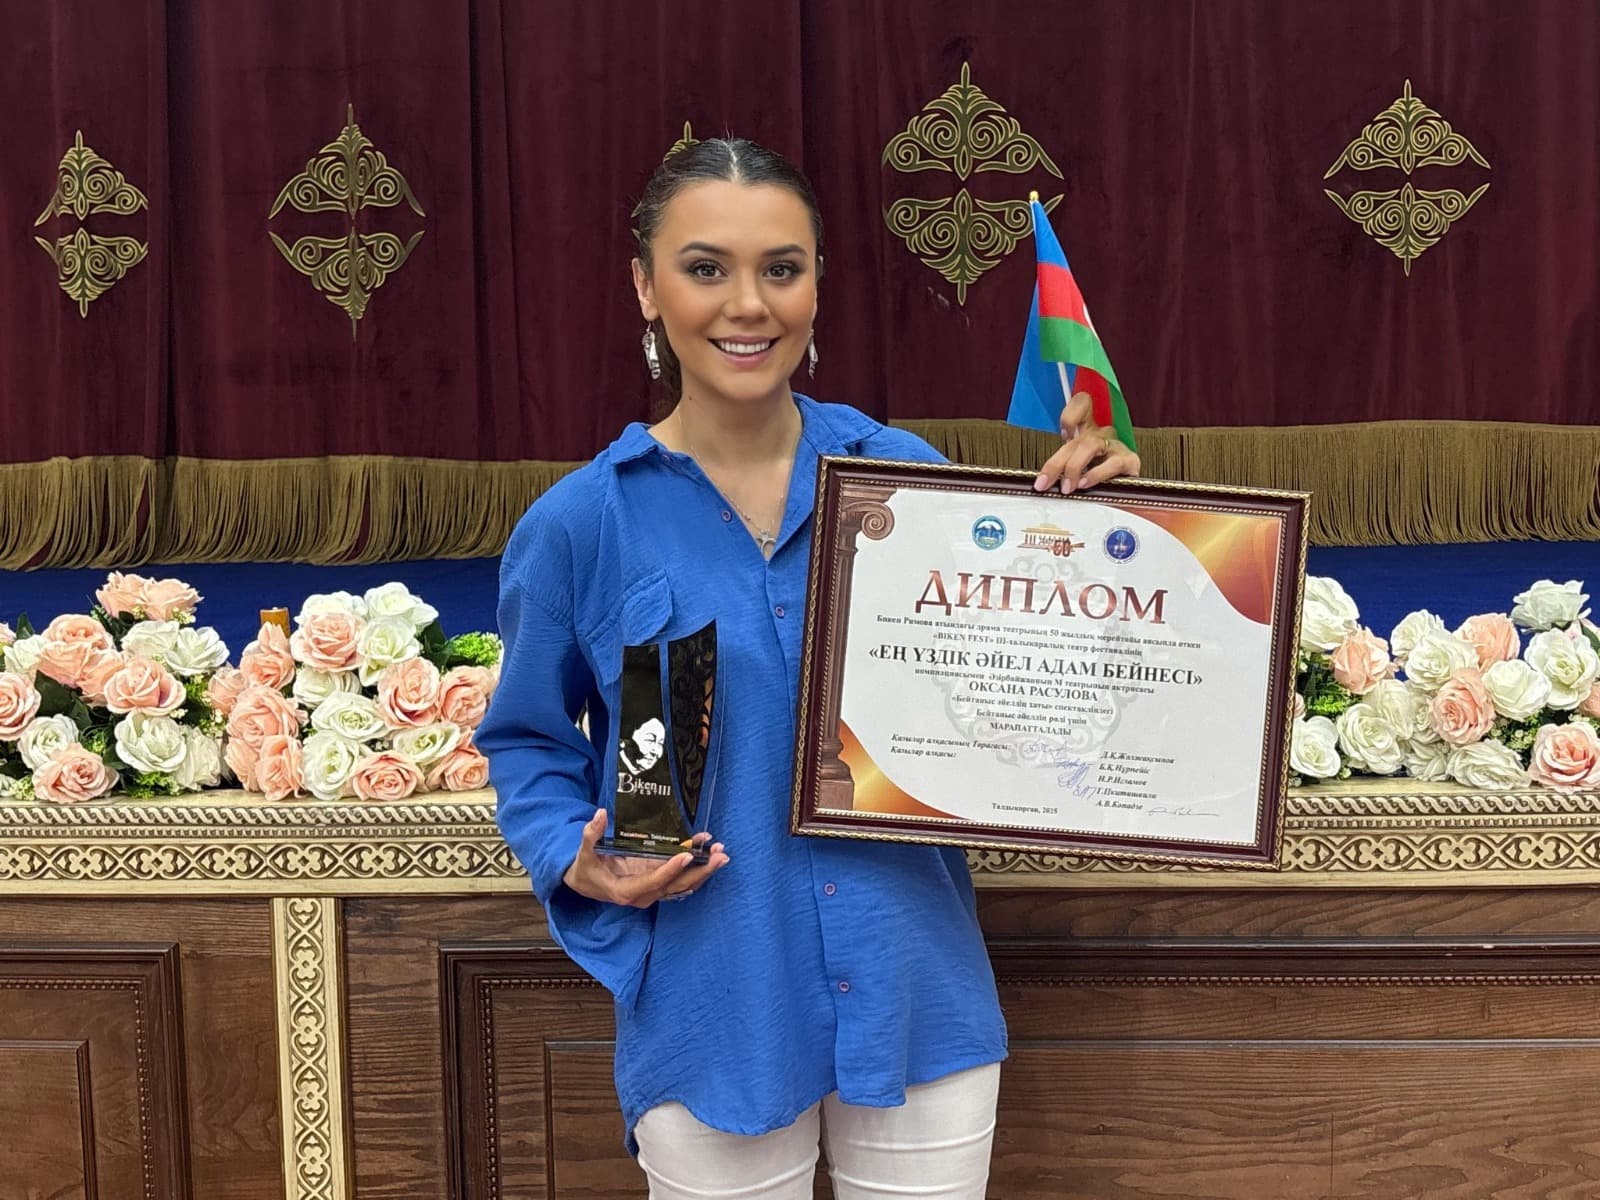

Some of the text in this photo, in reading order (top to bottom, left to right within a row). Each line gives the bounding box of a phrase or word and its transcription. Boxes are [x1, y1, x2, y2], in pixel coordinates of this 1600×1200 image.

[916, 570, 1168, 624] ДИПЛОМ
[904, 617, 932, 626] Римова
[976, 624, 1000, 633] драма
[1050, 629, 1058, 637] 50
[934, 632, 964, 641] «BIKEN
[968, 634, 994, 643] FEST»
[1067, 644, 1088, 652] театр
[869, 644, 1202, 686] «ЕҢ ҮЗДІК ӘЙЕЛ АДАМ БЕЙНЕСІ»
[969, 681, 1098, 701] ОКСАНА РАСУЛОВА
[976, 708, 1015, 720] Бейтаныс
[990, 722, 1072, 736] МАРАПАТТАЛАДЫ
[617, 772, 670, 796] Biken III
